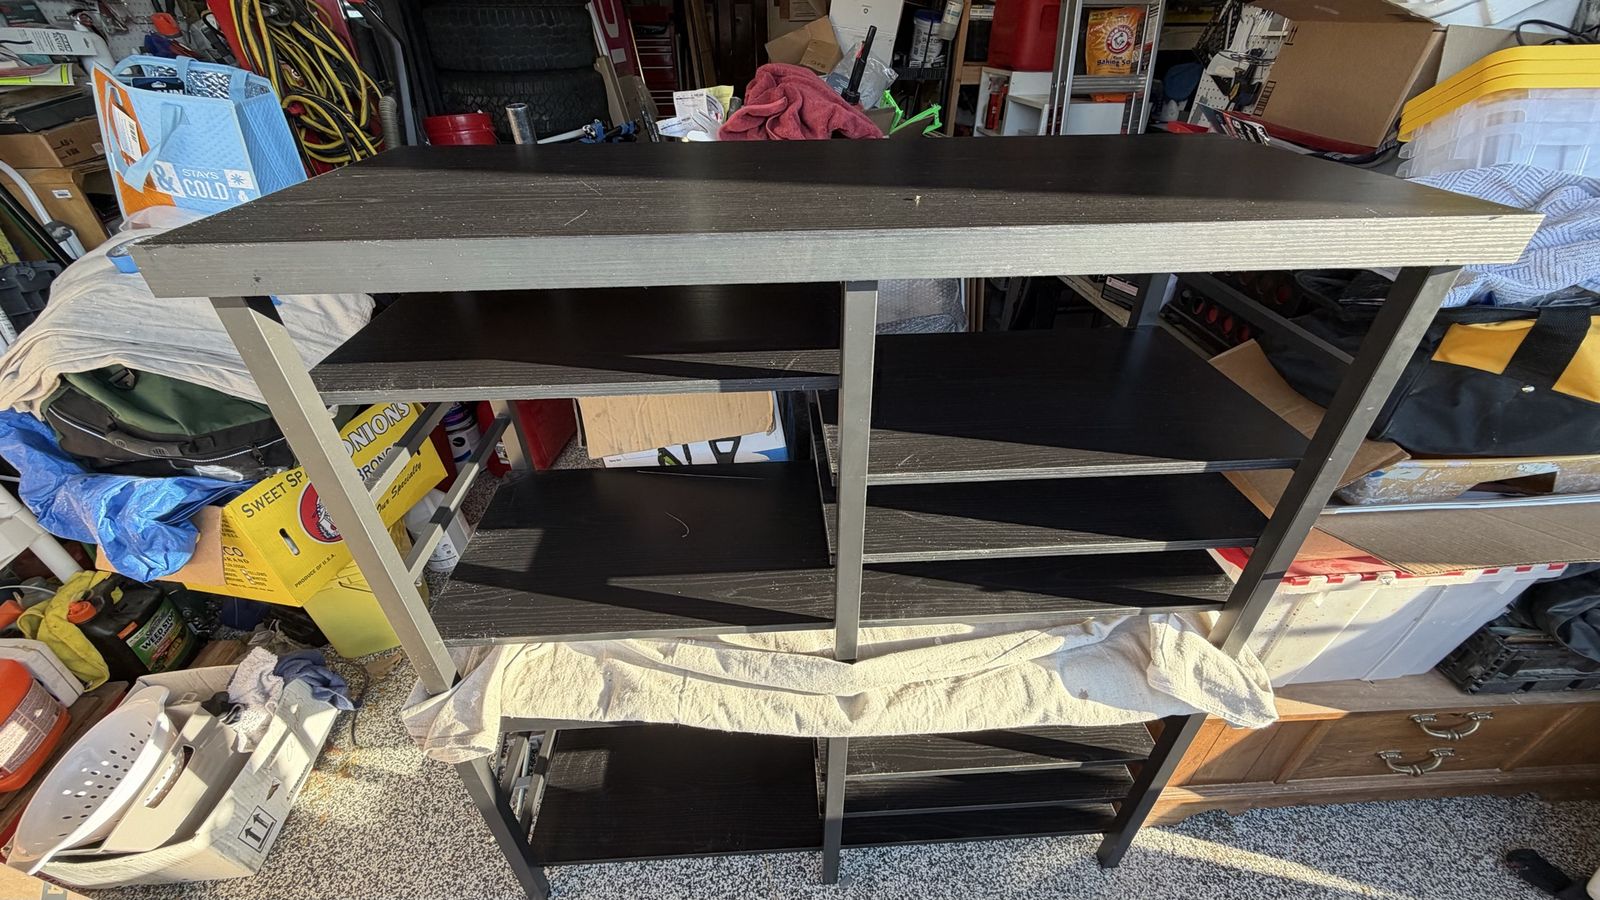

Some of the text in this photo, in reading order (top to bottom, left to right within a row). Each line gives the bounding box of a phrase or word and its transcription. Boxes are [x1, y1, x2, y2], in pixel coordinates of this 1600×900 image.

[1097, 58, 1120, 67] Baking
[153, 163, 181, 194] &
[182, 168, 219, 180] STAYS
[182, 178, 229, 200] COLD
[391, 461, 422, 499] Specialty
[241, 482, 288, 519] SWEET
[222, 546, 244, 558] CO
[224, 556, 250, 565] RAND
[294, 569, 317, 588] PRODUCE
[315, 563, 325, 573] OF
[140, 626, 164, 650] WEED
